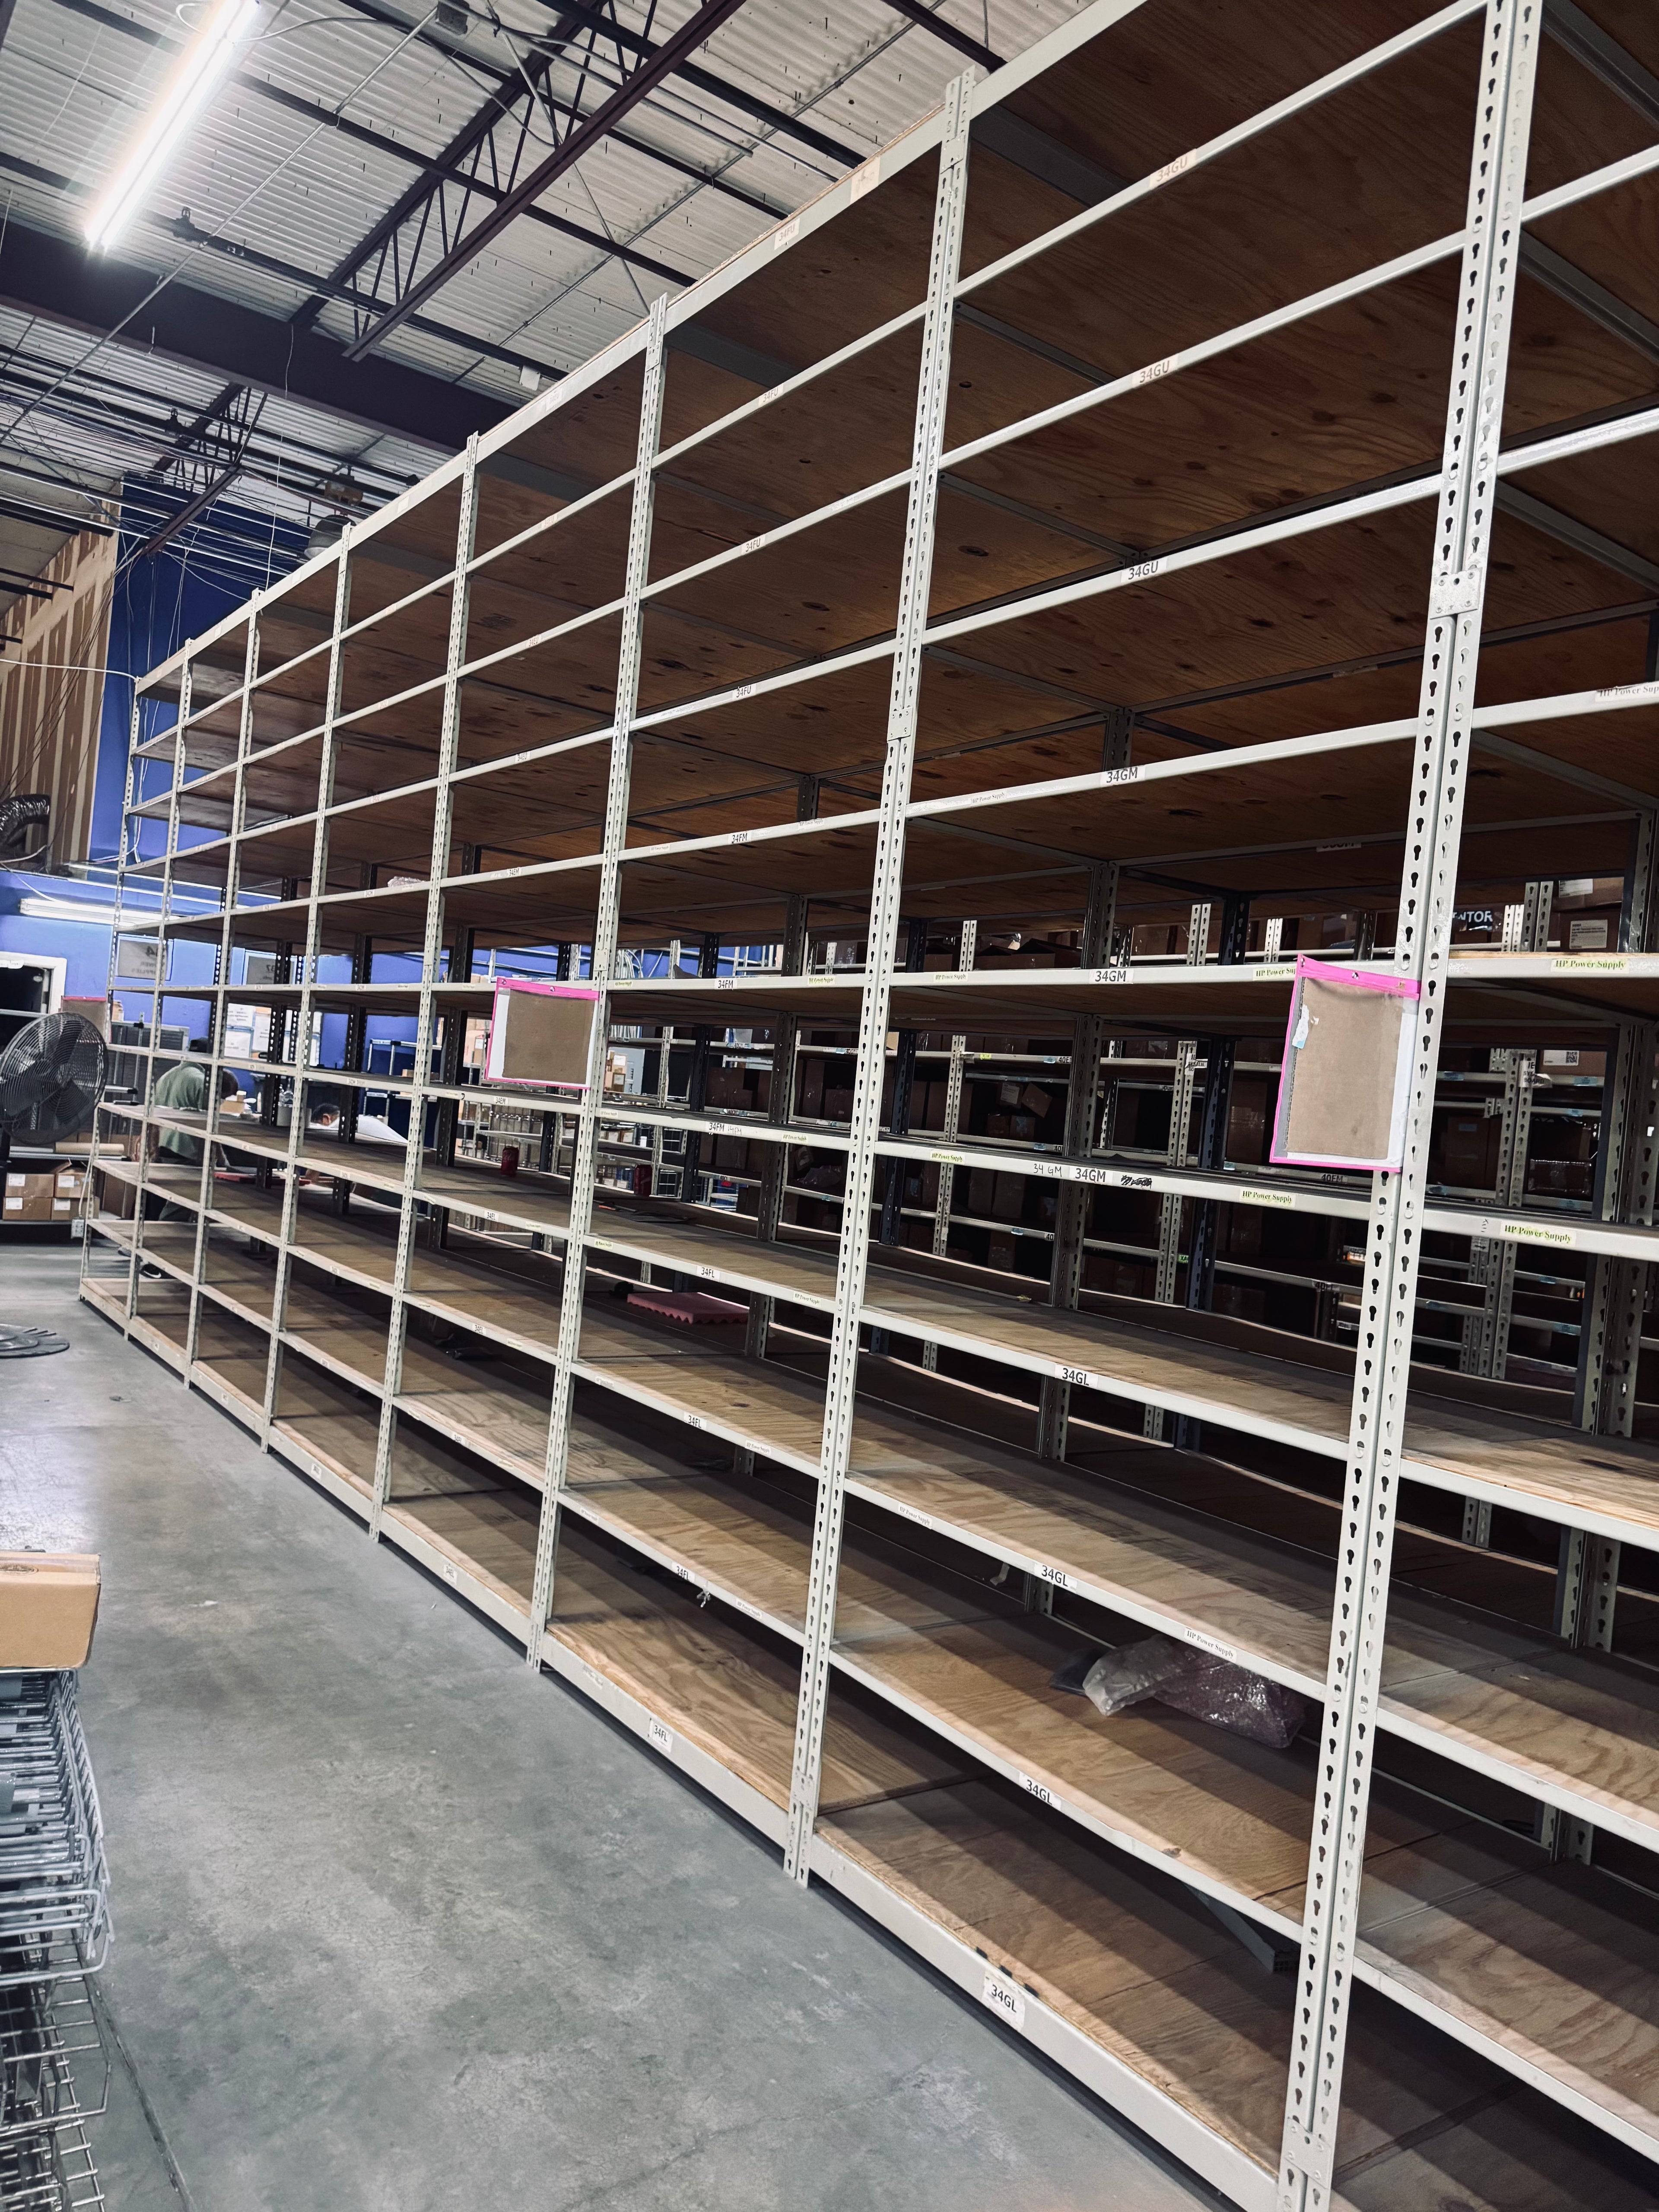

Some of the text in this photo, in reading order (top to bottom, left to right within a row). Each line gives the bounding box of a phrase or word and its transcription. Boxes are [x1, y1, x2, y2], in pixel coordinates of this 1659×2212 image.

[1156, 155, 1188, 182] 34GU
[1139, 360, 1170, 384] 34GU
[763, 387, 779, 403] 34FU
[746, 538, 761, 552] 34FU
[1128, 560, 1158, 580] 34GU
[736, 685, 751, 698] 34FU
[1616, 684, 1640, 695] Power
[1106, 767, 1138, 783] 34GM
[731, 833, 747, 844] 34FM
[1256, 968, 1265, 977] HP
[1267, 968, 1285, 976] Power
[1597, 960, 1624, 970] Supply
[1095, 970, 1127, 982] 34GM
[718, 980, 734, 988] 34FM
[709, 1123, 725, 1132] 34FM
[1033, 1163, 1062, 1177] 34 GM
[1075, 1168, 1106, 1183] 34GM
[1253, 1192, 1270, 1200] Power
[1272, 1193, 1292, 1203] Supply
[1519, 1227, 1542, 1236] Power
[1544, 1231, 1571, 1244] Supply
[701, 1267, 715, 1278] 34FL
[1062, 1367, 1089, 1386] 34GL
[688, 1415, 702, 1429] 34FL
[906, 1508, 917, 1518] Power
[918, 1514, 930, 1526] Supply
[677, 1566, 690, 1581] 34FL
[1041, 1564, 1068, 1587] 34GL
[1187, 1630, 1233, 1659] HP Power Supply
[654, 1725, 667, 1742] 34FL
[1026, 1779, 1053, 1805] 34GL
[992, 1983, 1017, 2013] 34GL
